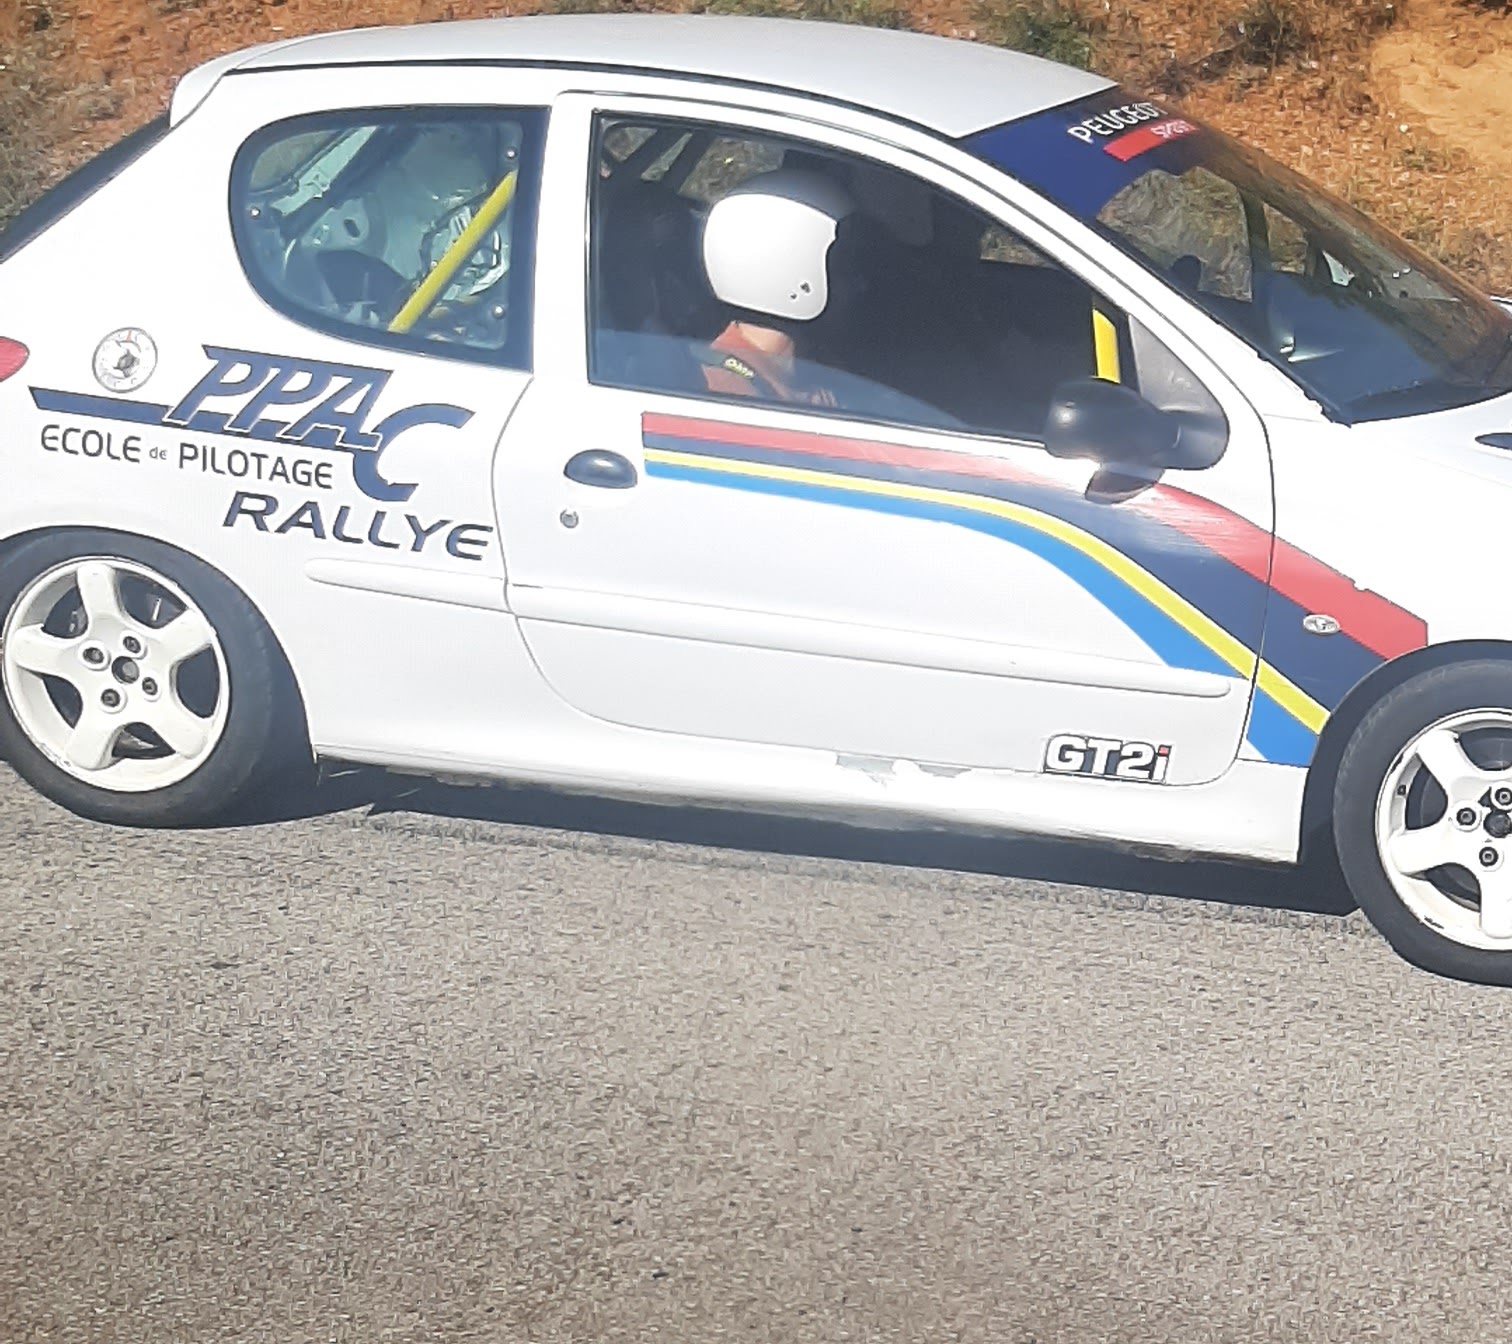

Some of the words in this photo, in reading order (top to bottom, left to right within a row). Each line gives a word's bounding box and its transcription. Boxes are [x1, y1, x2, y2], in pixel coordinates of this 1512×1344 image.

[1067, 102, 1168, 144] PEUGEOT
[162, 345, 476, 501] PPAC
[40, 424, 142, 463] ECOLE
[148, 446, 168, 461] de
[178, 443, 334, 490] PILOTAGE
[222, 491, 494, 560] RALLYE
[1045, 733, 1172, 785] GT2i
